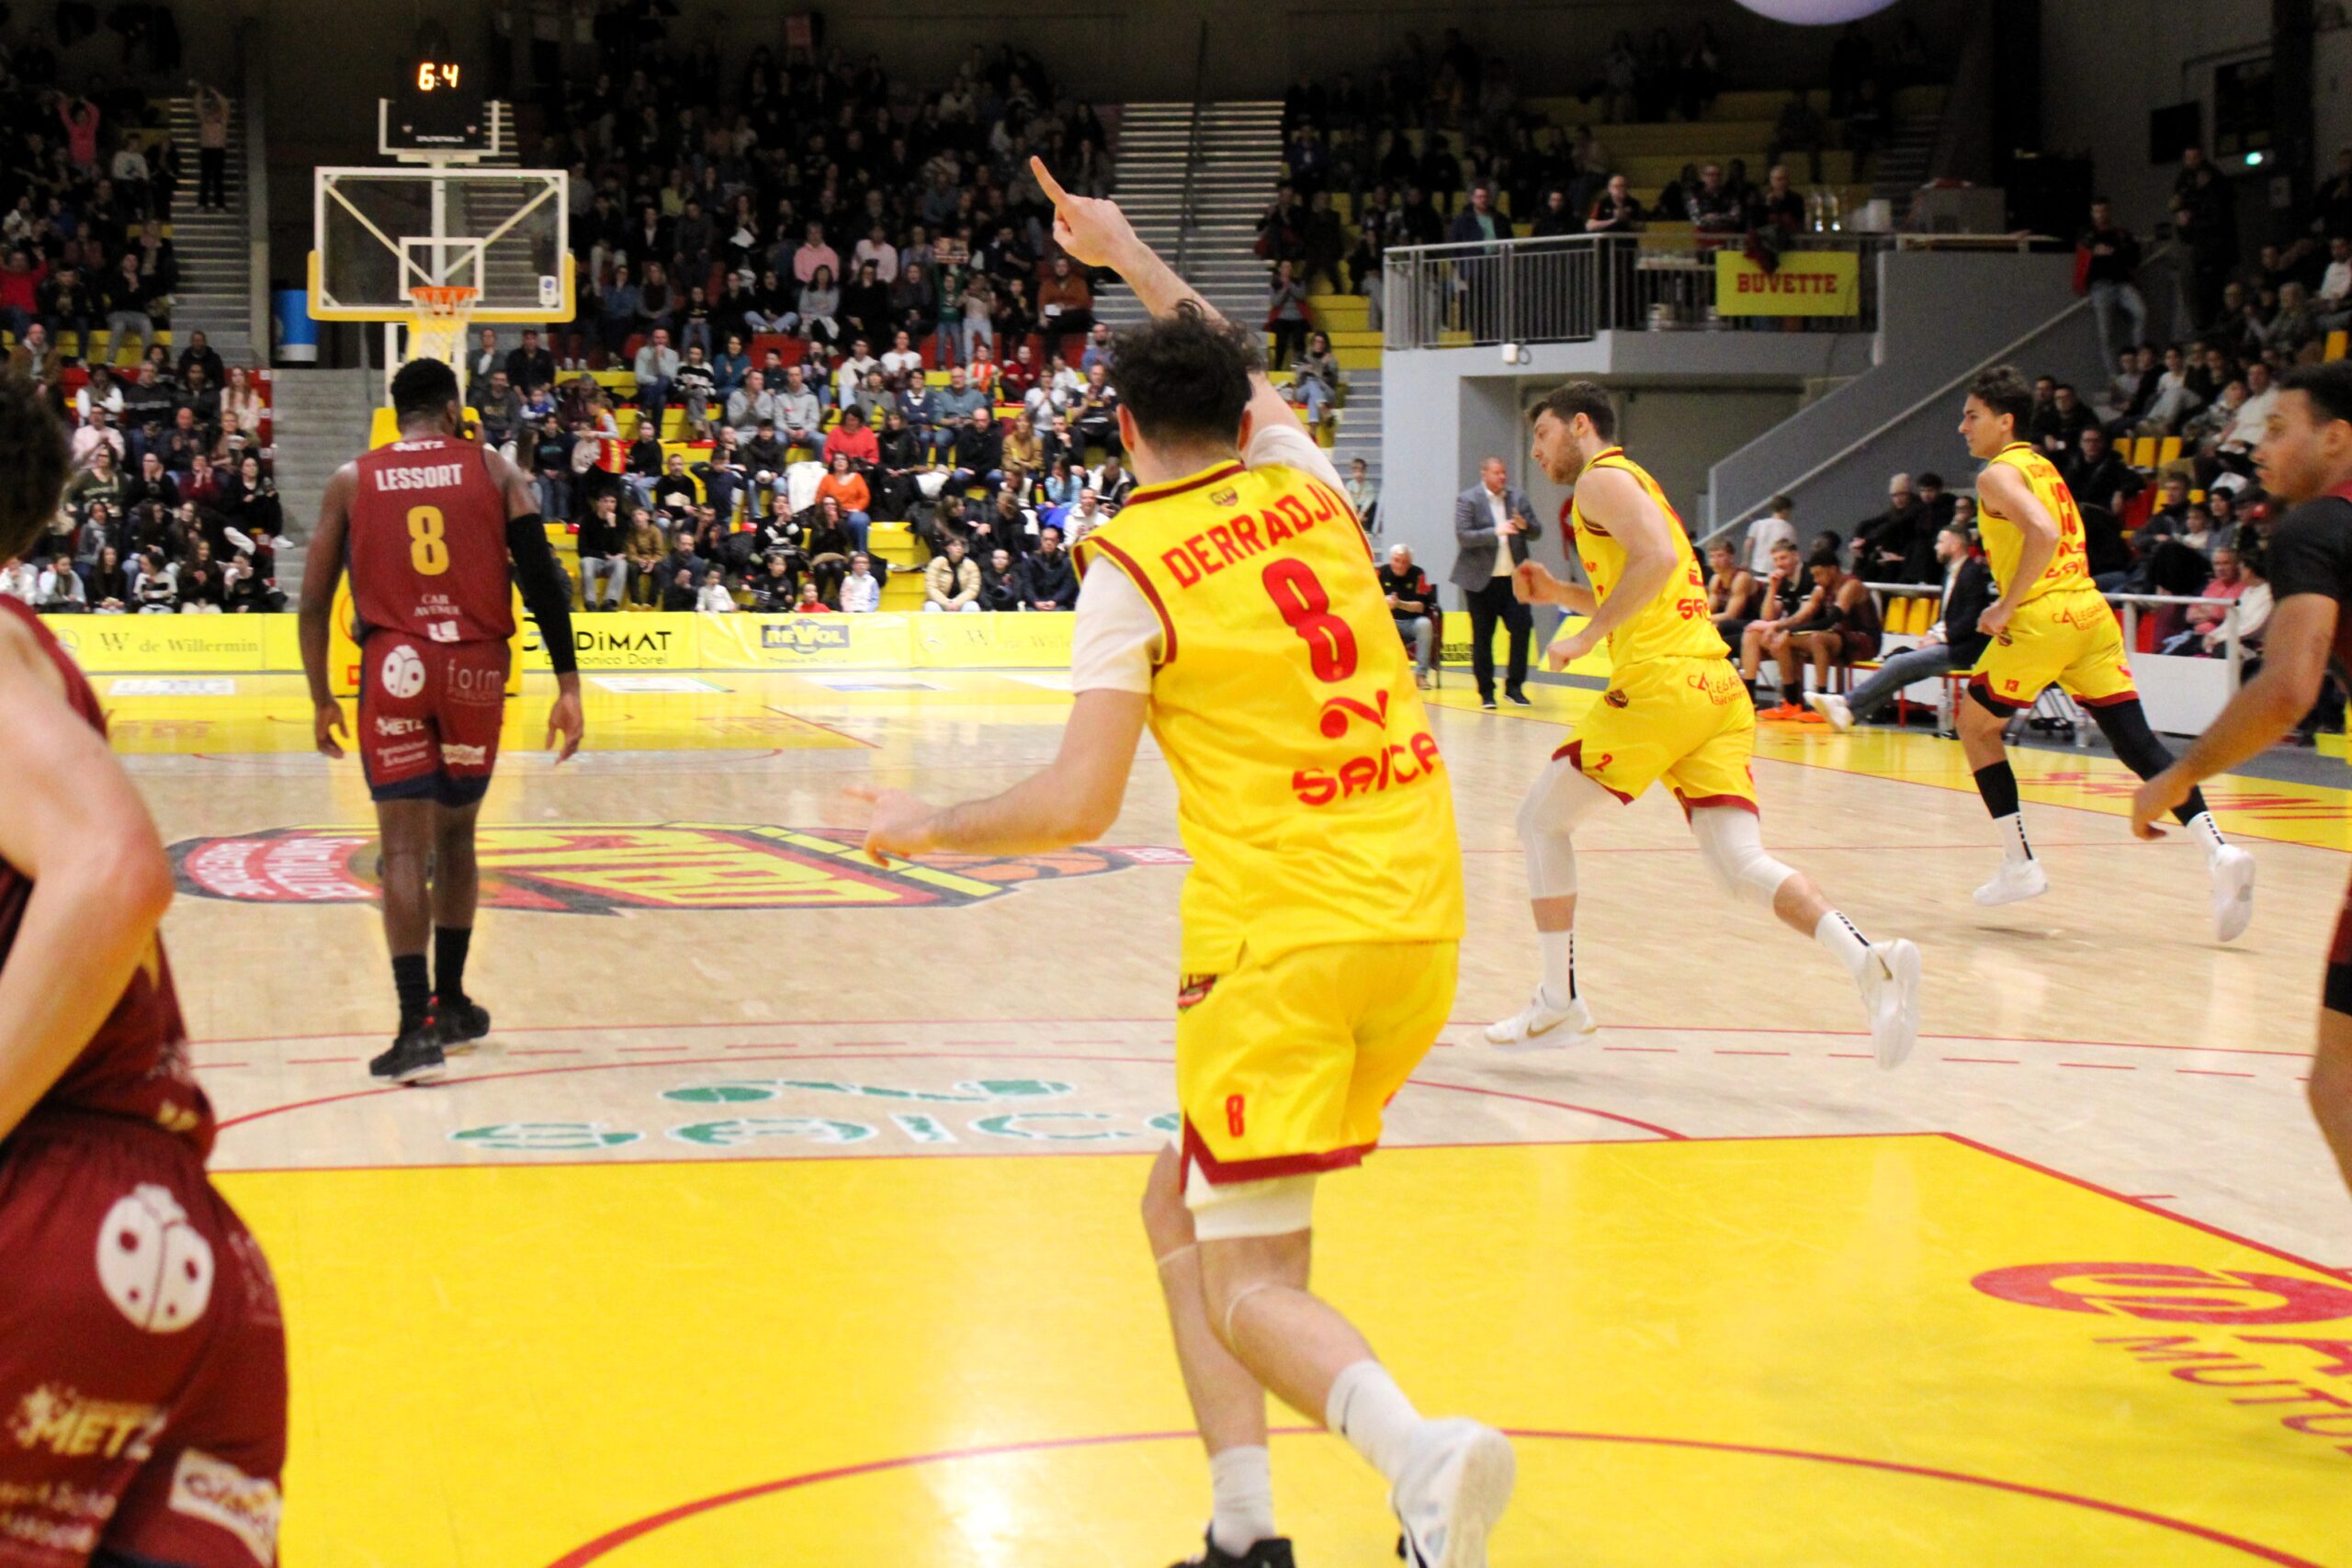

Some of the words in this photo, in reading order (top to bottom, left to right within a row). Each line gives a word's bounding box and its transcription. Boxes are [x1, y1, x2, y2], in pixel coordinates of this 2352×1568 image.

[1736, 273, 1838, 294] BUVETTE
[375, 463, 463, 491] LESSORT
[406, 504, 450, 576] 8
[1161, 483, 1340, 589] DERRADJI
[421, 593, 449, 604] CAR
[1261, 557, 1358, 682] 8
[99, 632, 130, 652] W
[140, 640, 162, 653] de
[167, 637, 259, 653] Willermin
[628, 653, 669, 665] Dorel
[447, 659, 502, 690] form
[2004, 678, 2020, 693] 13
[1594, 753, 1613, 773] 2
[1225, 1093, 1245, 1138] 8
